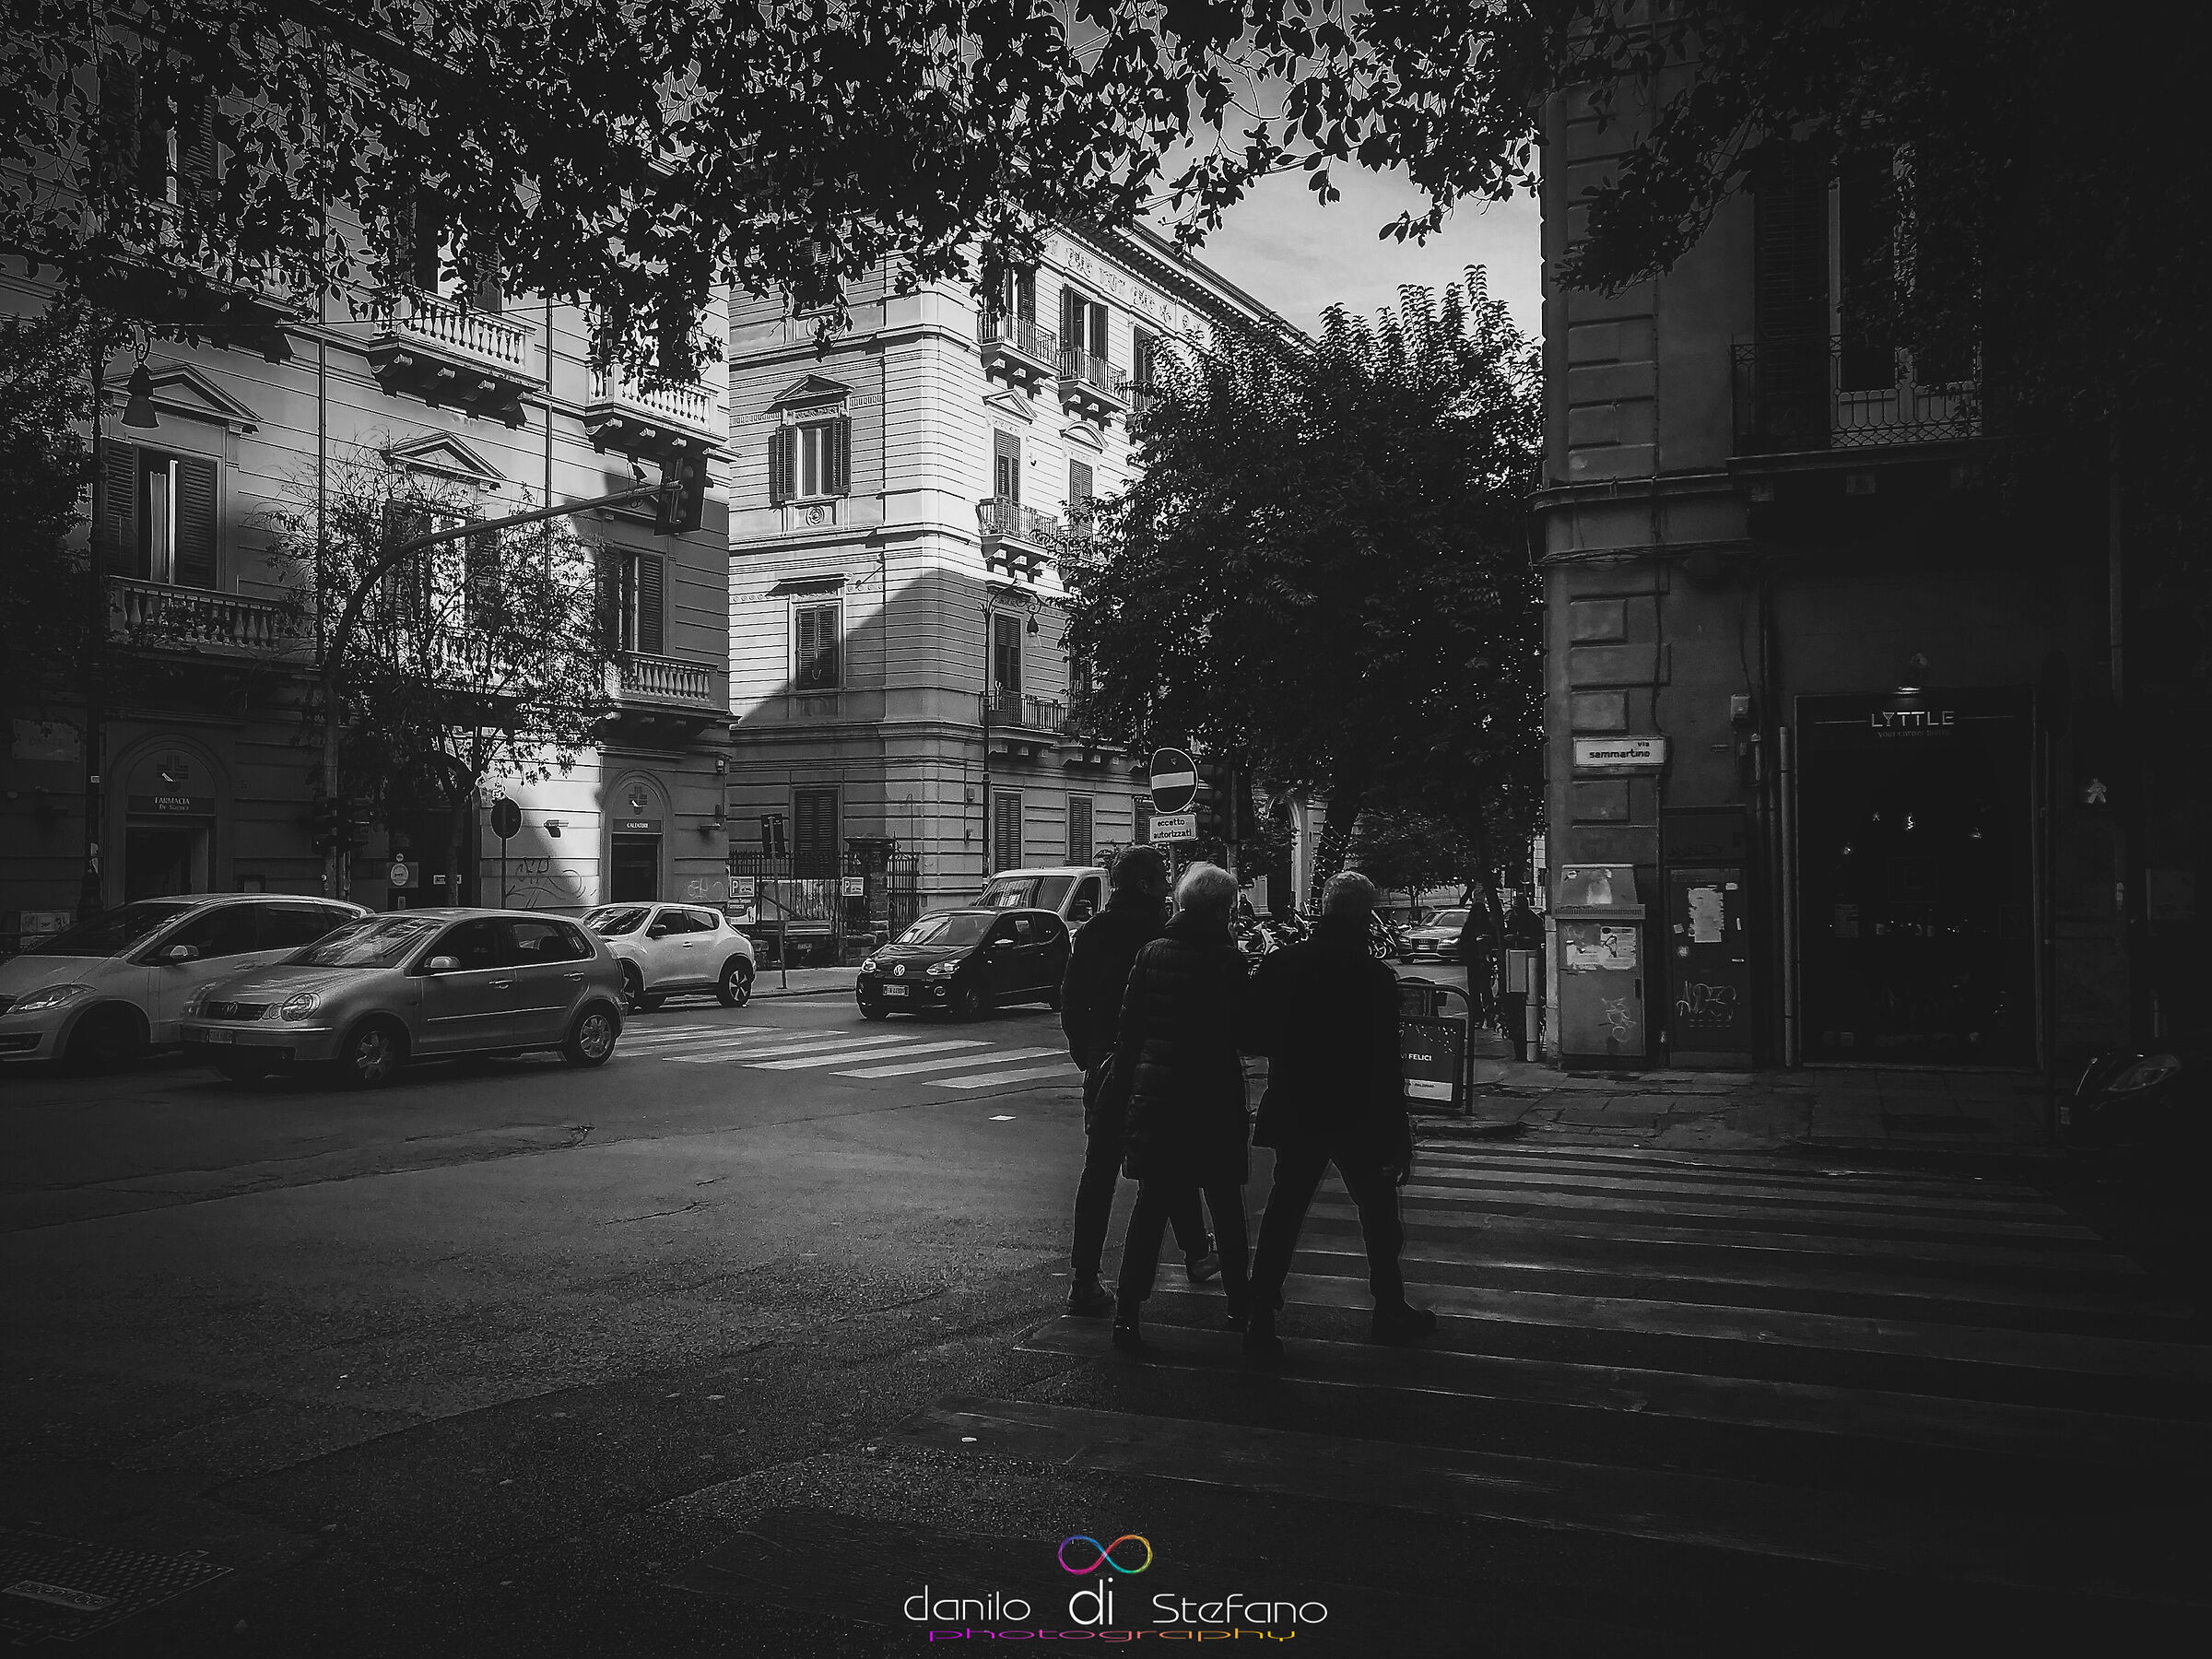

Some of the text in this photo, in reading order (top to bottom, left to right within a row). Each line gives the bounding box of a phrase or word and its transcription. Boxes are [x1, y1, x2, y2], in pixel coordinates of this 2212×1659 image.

[1871, 711, 1955, 727] LYTTLE
[1589, 747, 1651, 759] sammartino
[154, 796, 190, 806] FARMACIA
[1157, 818, 1185, 827] eccetto
[1153, 828, 1192, 839] autorizzati
[732, 880, 739, 893] P
[844, 880, 851, 893] P
[1408, 1053, 1433, 1062] FELICI
